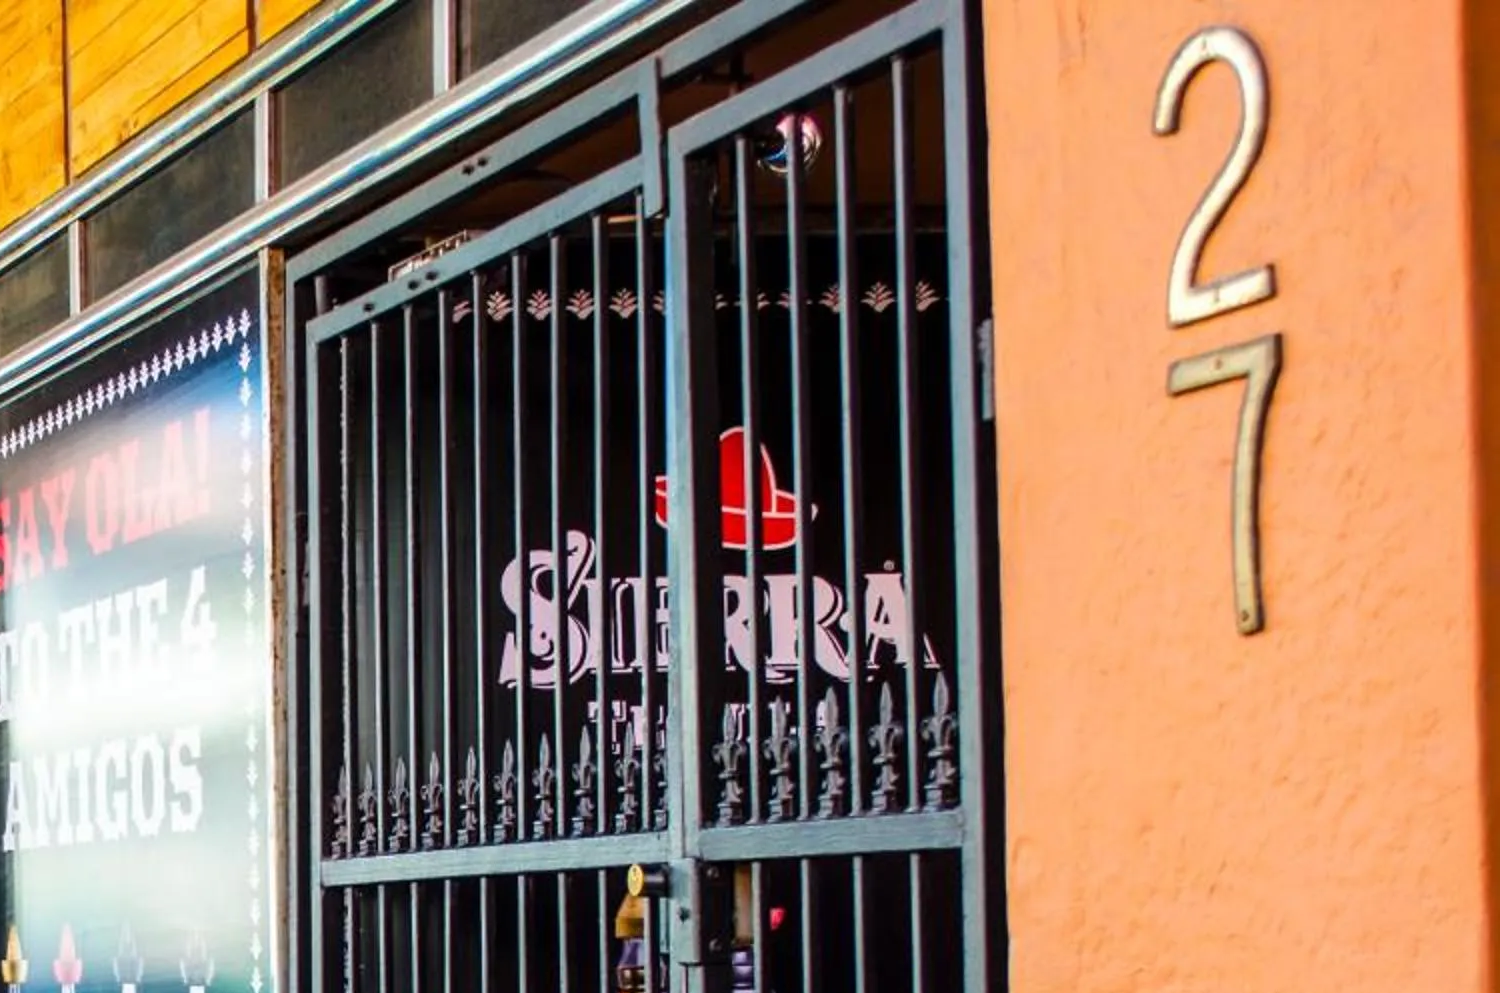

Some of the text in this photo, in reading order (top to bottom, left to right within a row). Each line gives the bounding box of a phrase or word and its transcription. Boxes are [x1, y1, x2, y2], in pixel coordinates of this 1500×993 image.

[85, 407, 210, 557] OLA!
[58, 578, 172, 708] THE
[180, 564, 217, 678] 4
[2, 727, 204, 854] AMIGOS
